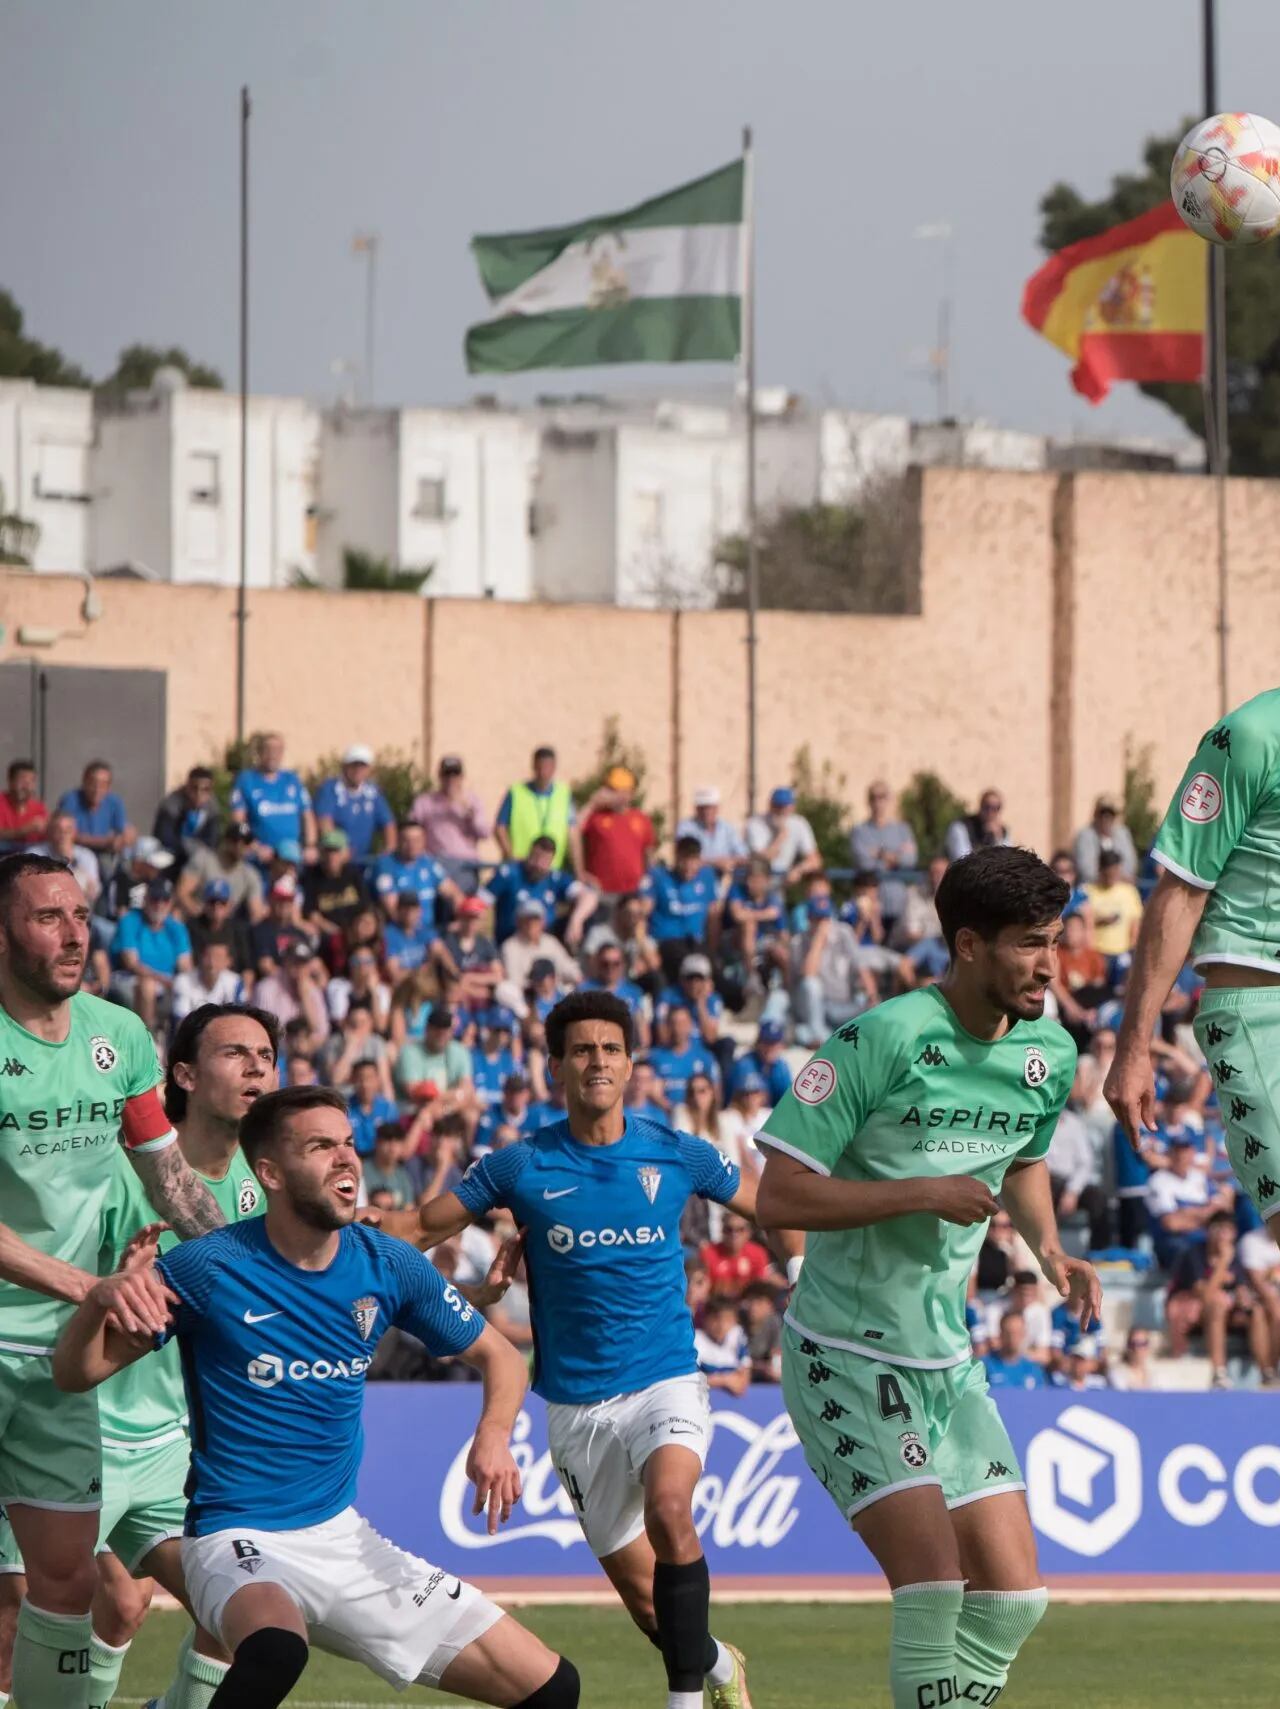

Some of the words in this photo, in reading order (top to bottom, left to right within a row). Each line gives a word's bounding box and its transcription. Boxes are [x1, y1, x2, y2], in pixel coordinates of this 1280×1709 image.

[19, 1134, 108, 1156] ACADEMY
[912, 1139, 1008, 1155] ACADEMY
[578, 1225, 666, 1247] COASA
[876, 1374, 912, 1423] 4
[232, 1539, 260, 1560] 6
[58, 1648, 90, 1674] CD
[962, 1681, 1002, 1707] CD
